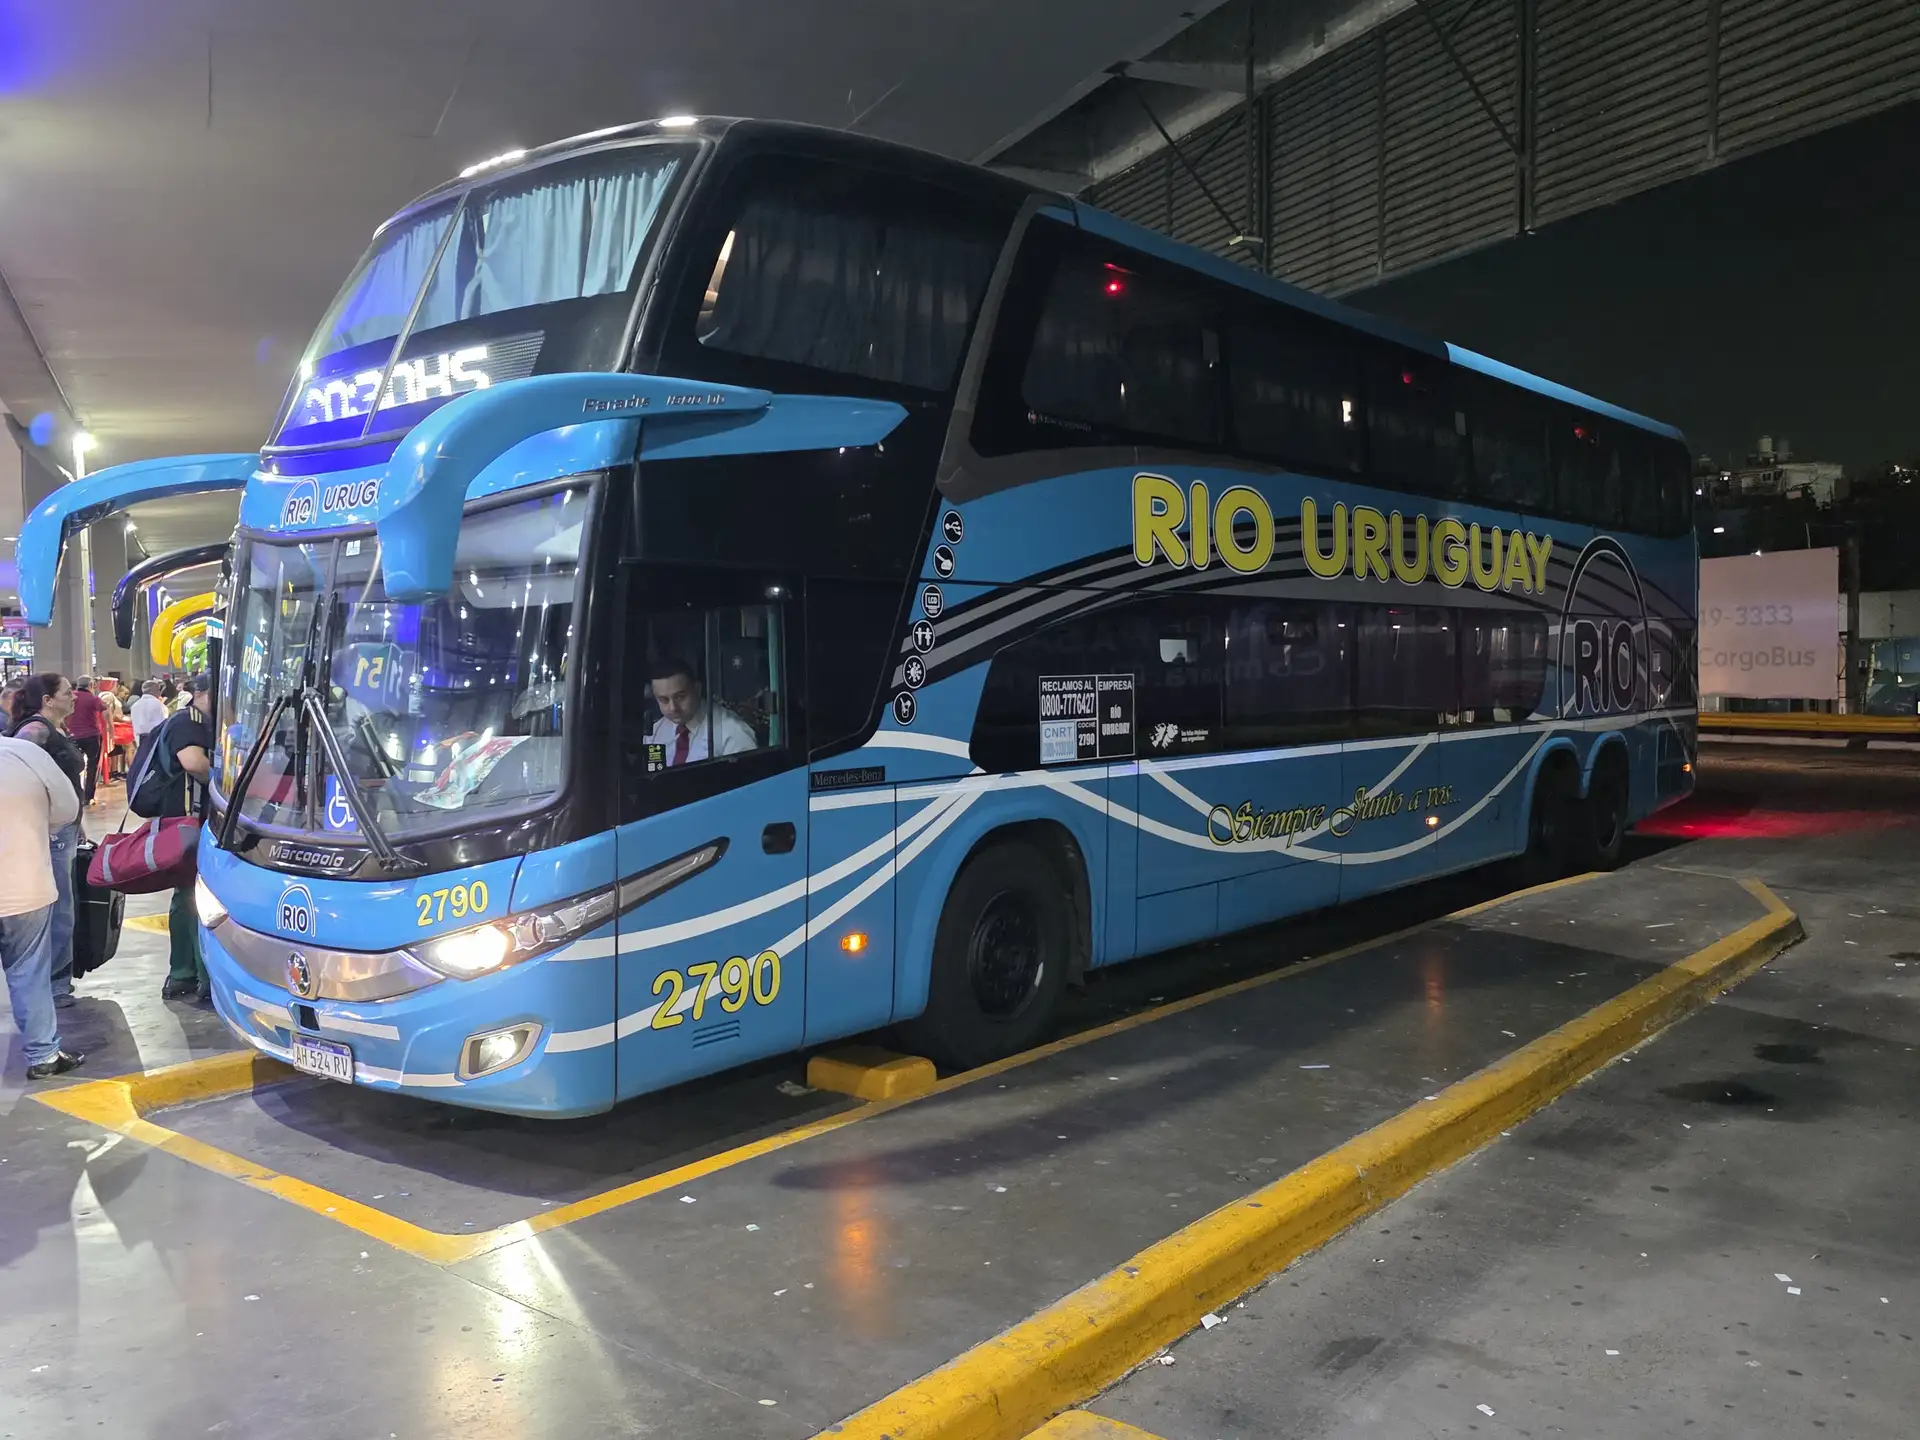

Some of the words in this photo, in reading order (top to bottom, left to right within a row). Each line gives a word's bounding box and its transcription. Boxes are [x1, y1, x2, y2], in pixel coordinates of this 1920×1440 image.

[285, 496, 312, 525] RIO
[322, 478, 384, 513] URUG
[1132, 472, 1275, 575] RIO
[1301, 496, 1553, 594] URUGUAY
[1572, 618, 1638, 715] RIO
[1698, 646, 1816, 671] CargoBus
[1041, 681, 1083, 692] RECLAMOS
[1083, 680, 1094, 690] AL
[1098, 680, 1132, 691] EMPRESA
[1041, 692, 1095, 717] 0800-7776427
[1044, 725, 1073, 739] CNRT
[1077, 721, 1096, 729] COCHE
[1078, 733, 1095, 747] 2790
[814, 769, 883, 787] Mercedes-Benz
[1207, 800, 1326, 849] Siempre
[268, 844, 345, 868] Marcopolo
[416, 880, 489, 927] 2790
[281, 904, 308, 932] RIO
[650, 949, 781, 1030] 2790
[296, 1046, 308, 1067] AH
[310, 1050, 330, 1072] 524
[333, 1056, 348, 1076] RV
